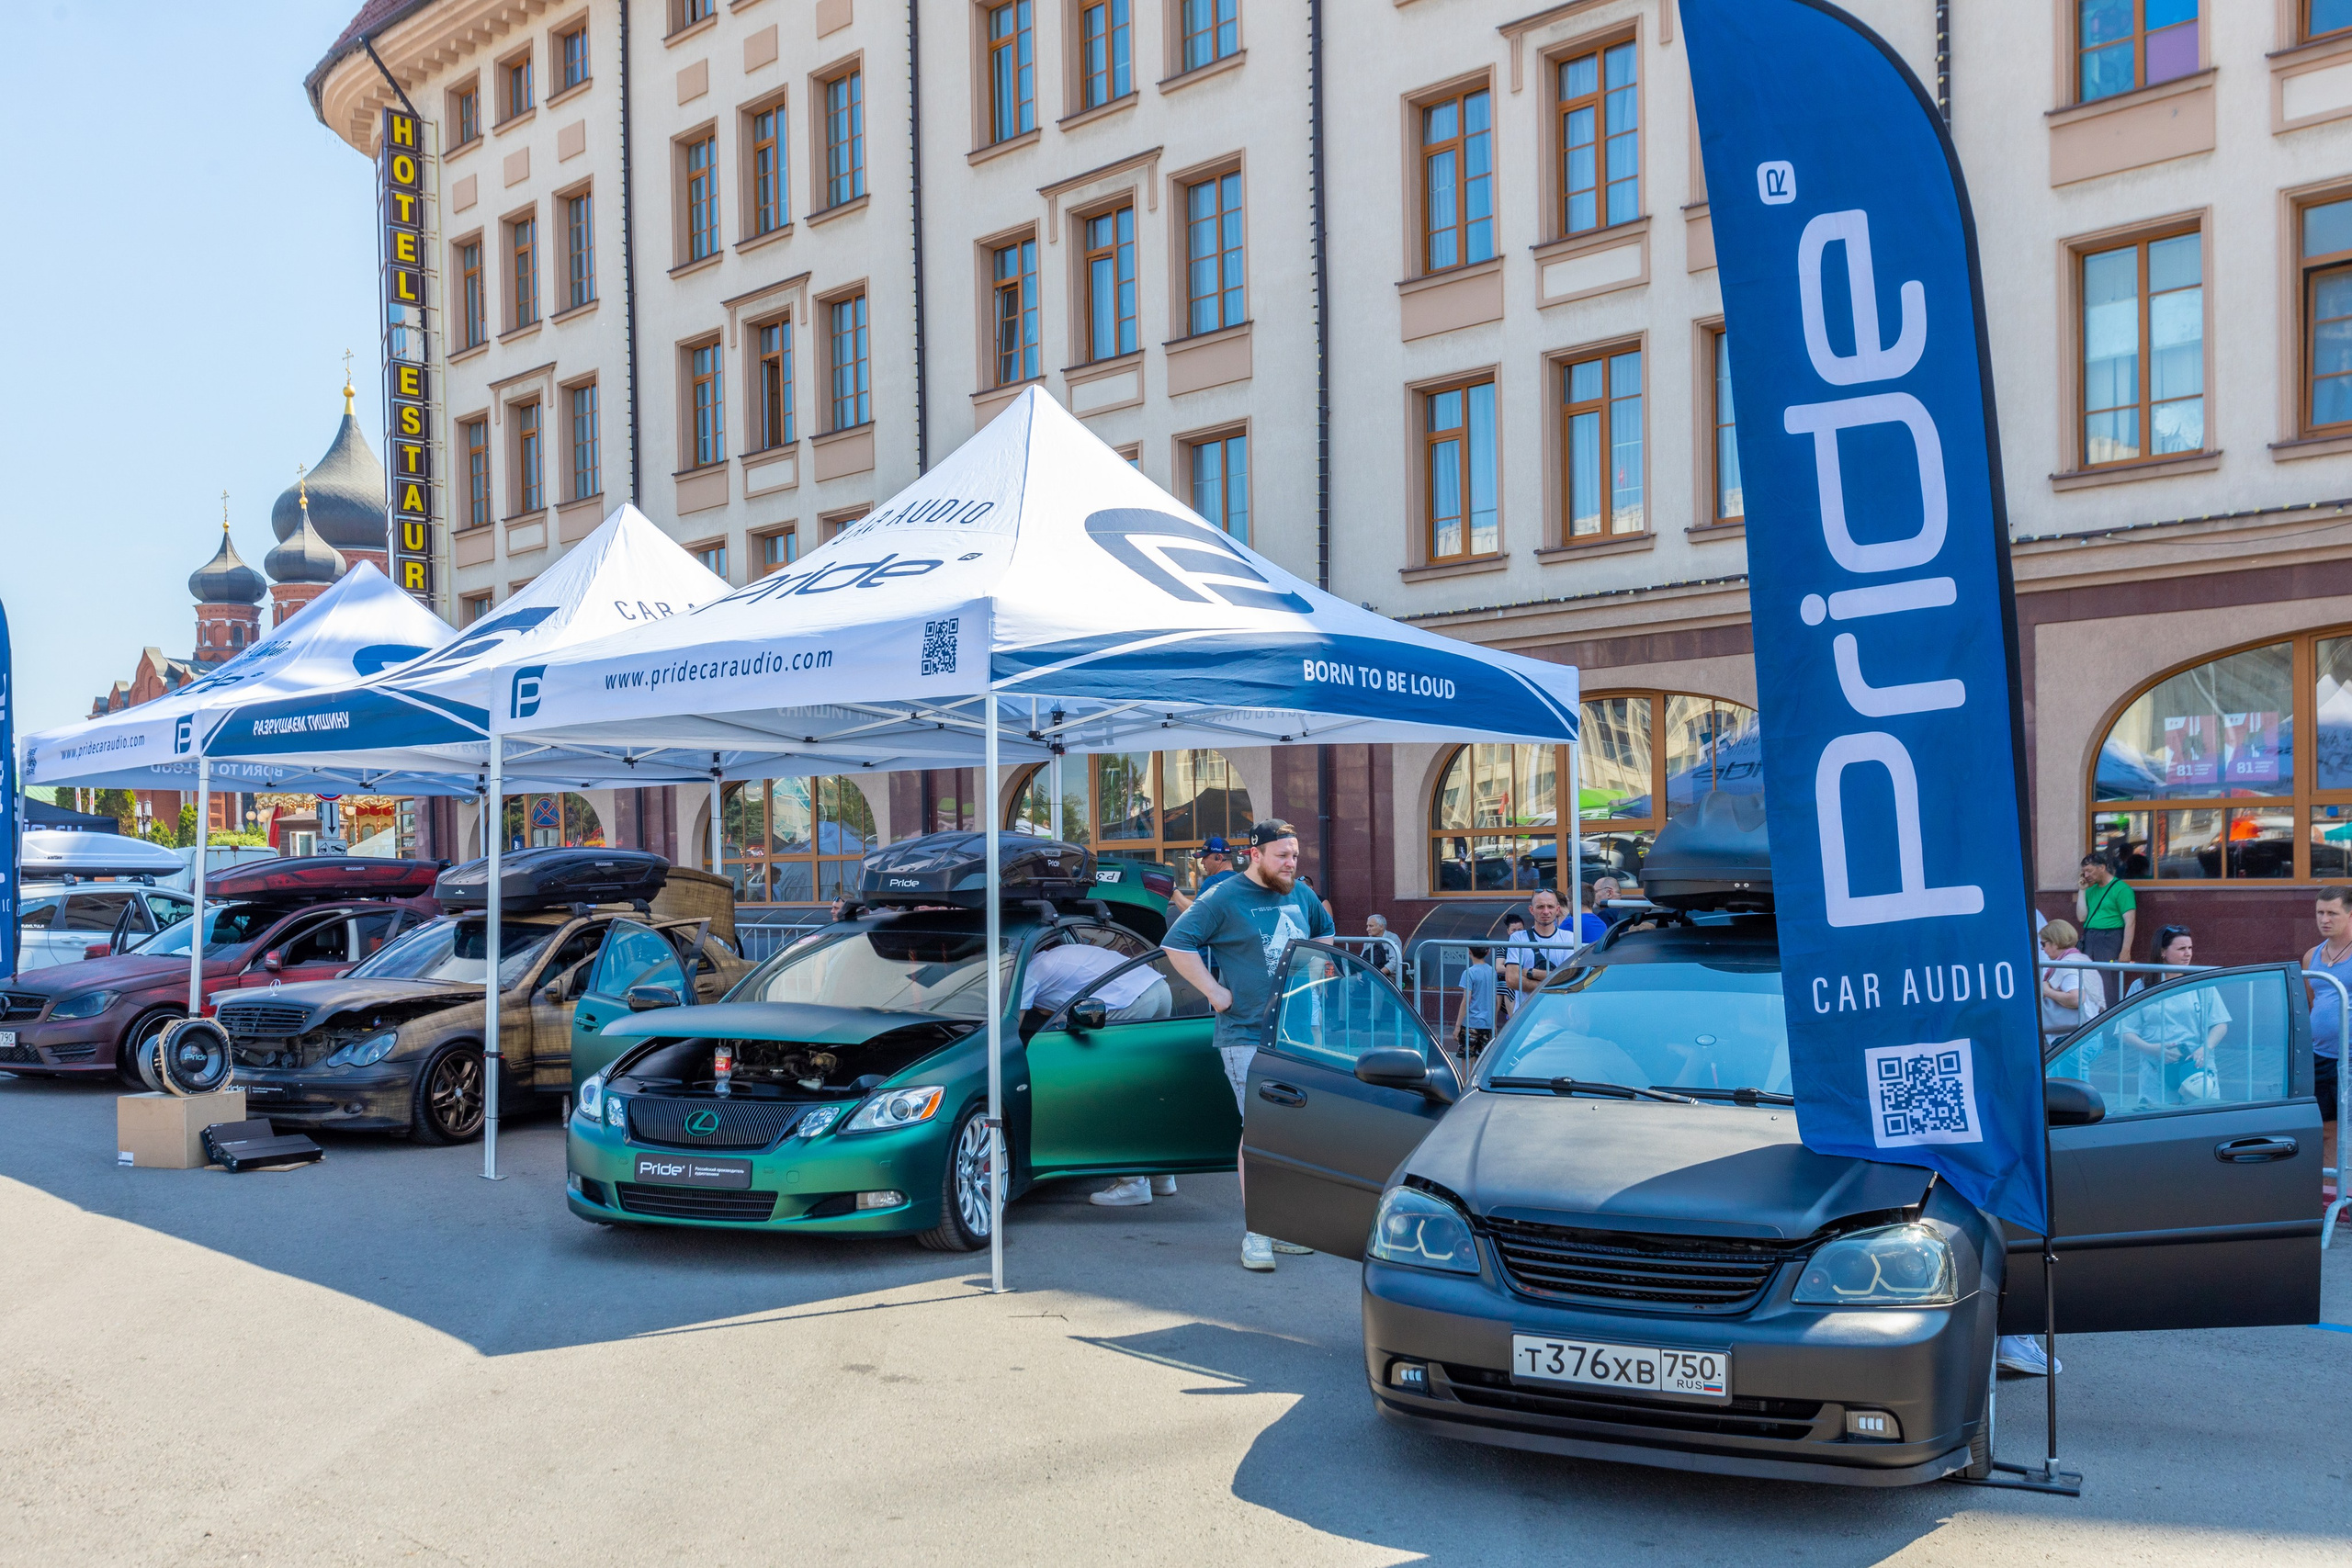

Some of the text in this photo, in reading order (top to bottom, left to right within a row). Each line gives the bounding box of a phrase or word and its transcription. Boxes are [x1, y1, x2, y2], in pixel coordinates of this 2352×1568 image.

[393, 115, 415, 301] HOTEL
[832, 499, 994, 546] CAR AUDIO
[1783, 209, 1985, 928] Pride
[614, 601, 673, 620] CAR
[605, 647, 833, 691] www.pridecaraudio.com
[1303, 659, 1456, 700] BORN TO BE LOUD
[253, 711, 349, 736] РАЗРУШАЕМ ТИШИНУ
[60, 734, 145, 761] www.pridecaraudio.com
[2177, 764, 2194, 777] 81
[2236, 761, 2255, 774] 81
[889, 878, 920, 888] Pride
[1812, 961, 2015, 1014] CAR AUDIO
[184, 1053, 208, 1062] Pride
[1663, 1353, 1716, 1381] 750
[1677, 1379, 1702, 1391] RUS
